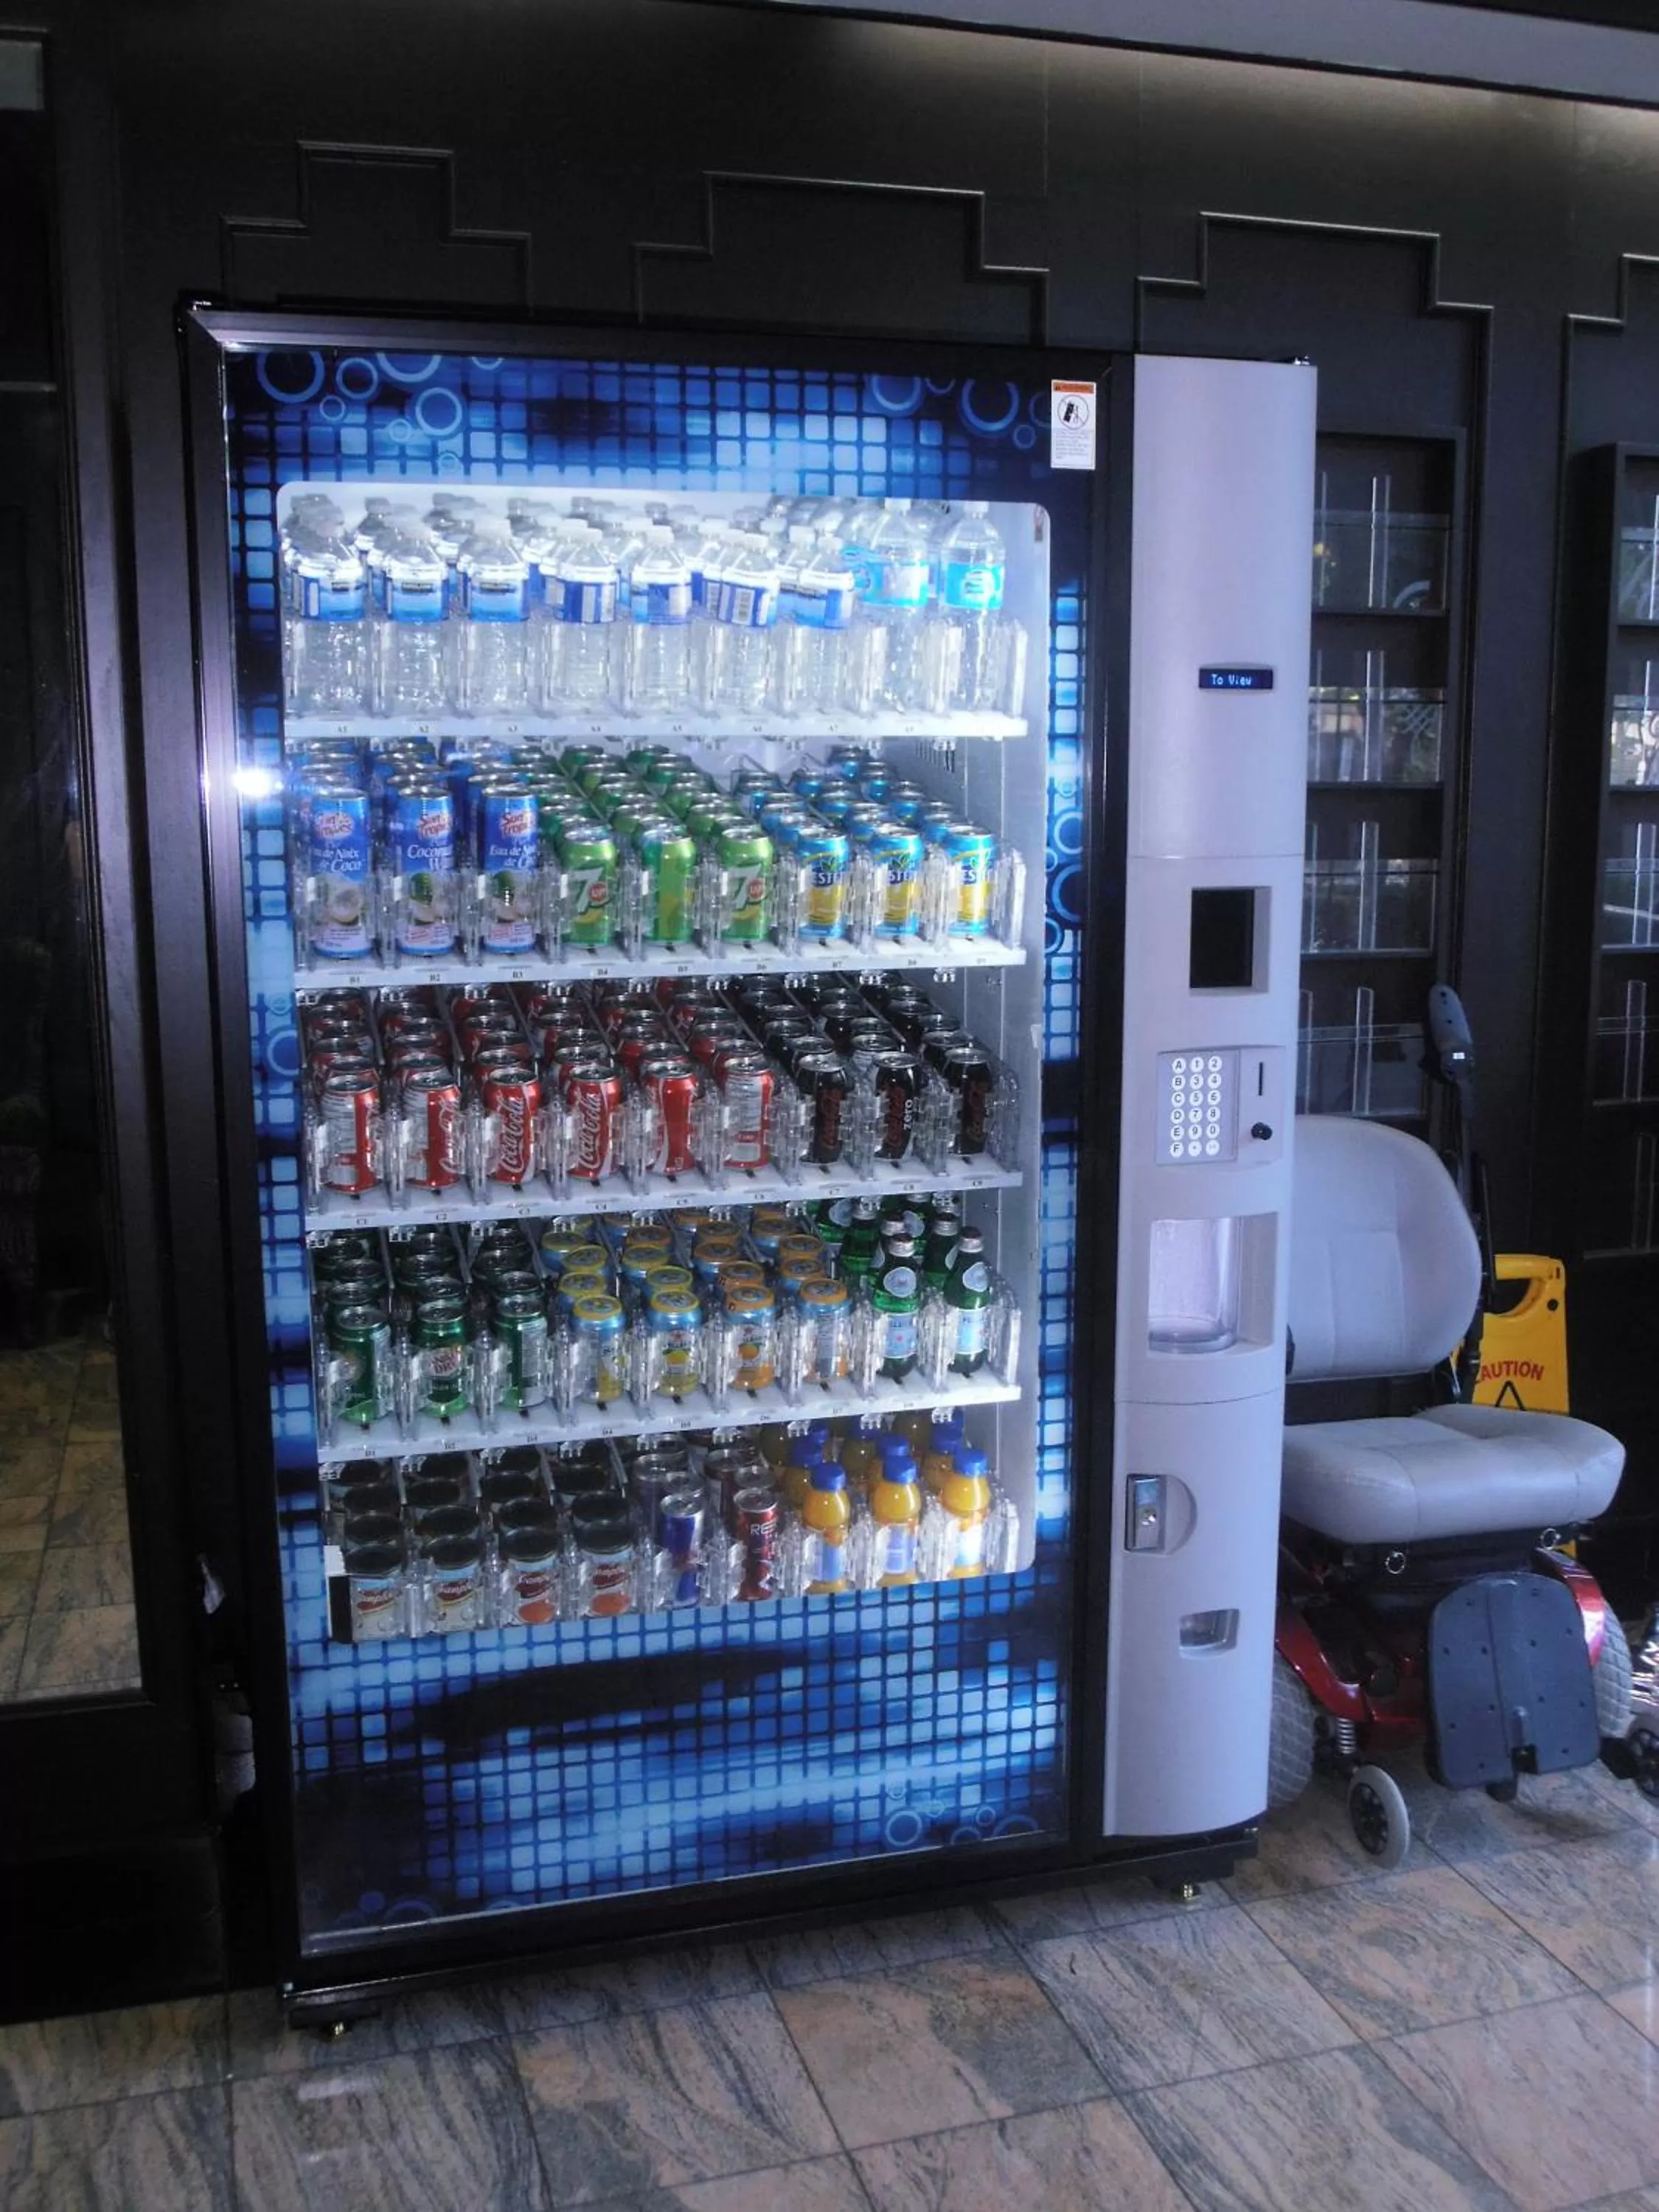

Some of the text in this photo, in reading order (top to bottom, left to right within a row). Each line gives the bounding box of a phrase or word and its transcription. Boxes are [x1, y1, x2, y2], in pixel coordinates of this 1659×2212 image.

[1211, 673, 1252, 686] To View
[1176, 1059, 1217, 1069] A 1 2
[1175, 1077, 1181, 1085] B
[1175, 1093, 1217, 1103] C 5 6
[1194, 1111, 1199, 1119] 7
[1174, 1126, 1215, 1136] E 9 0
[1173, 1144, 1179, 1152] F
[1480, 1360, 1545, 1381] AUTION
